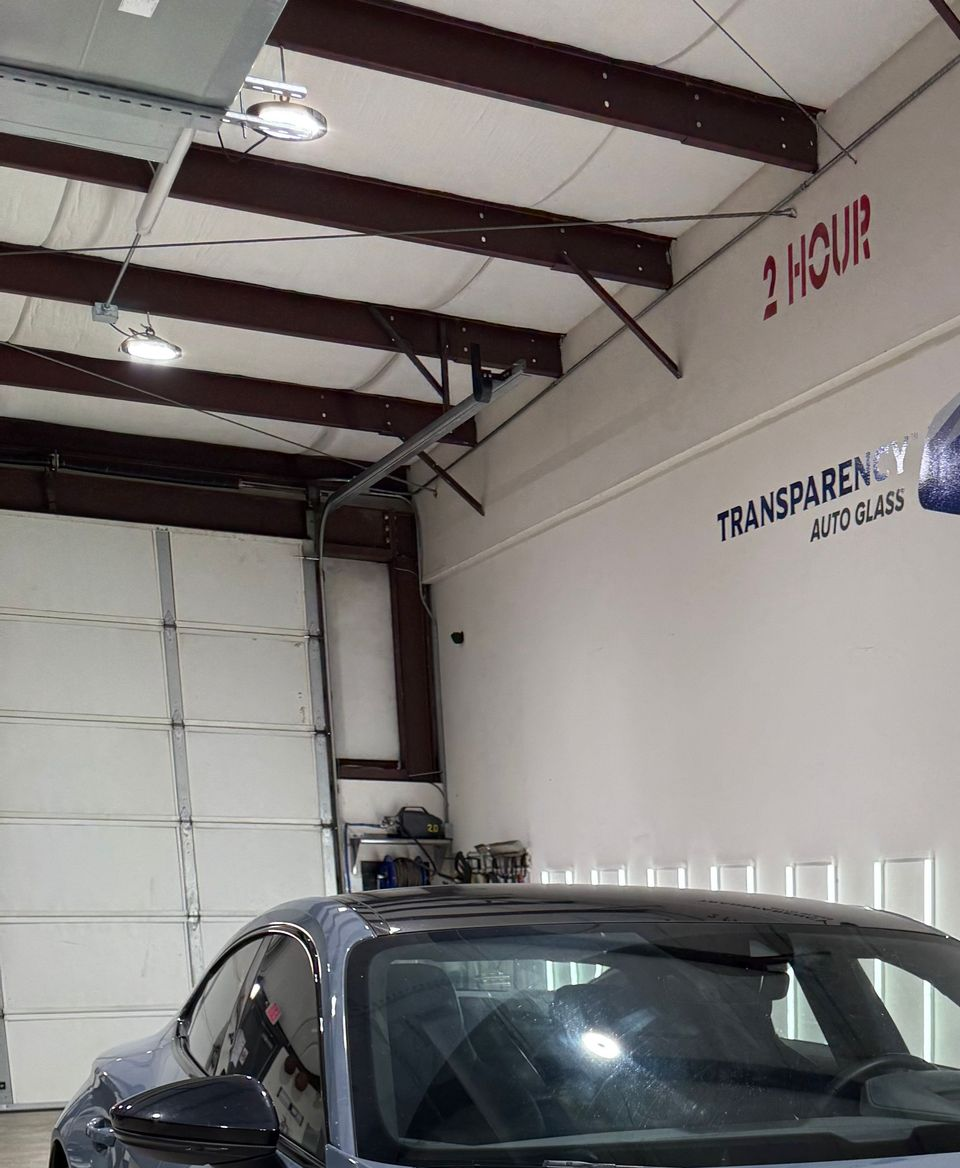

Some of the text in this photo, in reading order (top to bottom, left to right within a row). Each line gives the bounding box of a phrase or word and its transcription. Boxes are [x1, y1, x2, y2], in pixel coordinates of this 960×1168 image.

[763, 194, 871, 321] 2 HOUR
[716, 436, 909, 542] TRANSPARENCY
[810, 487, 905, 543] AUTO GLASS
